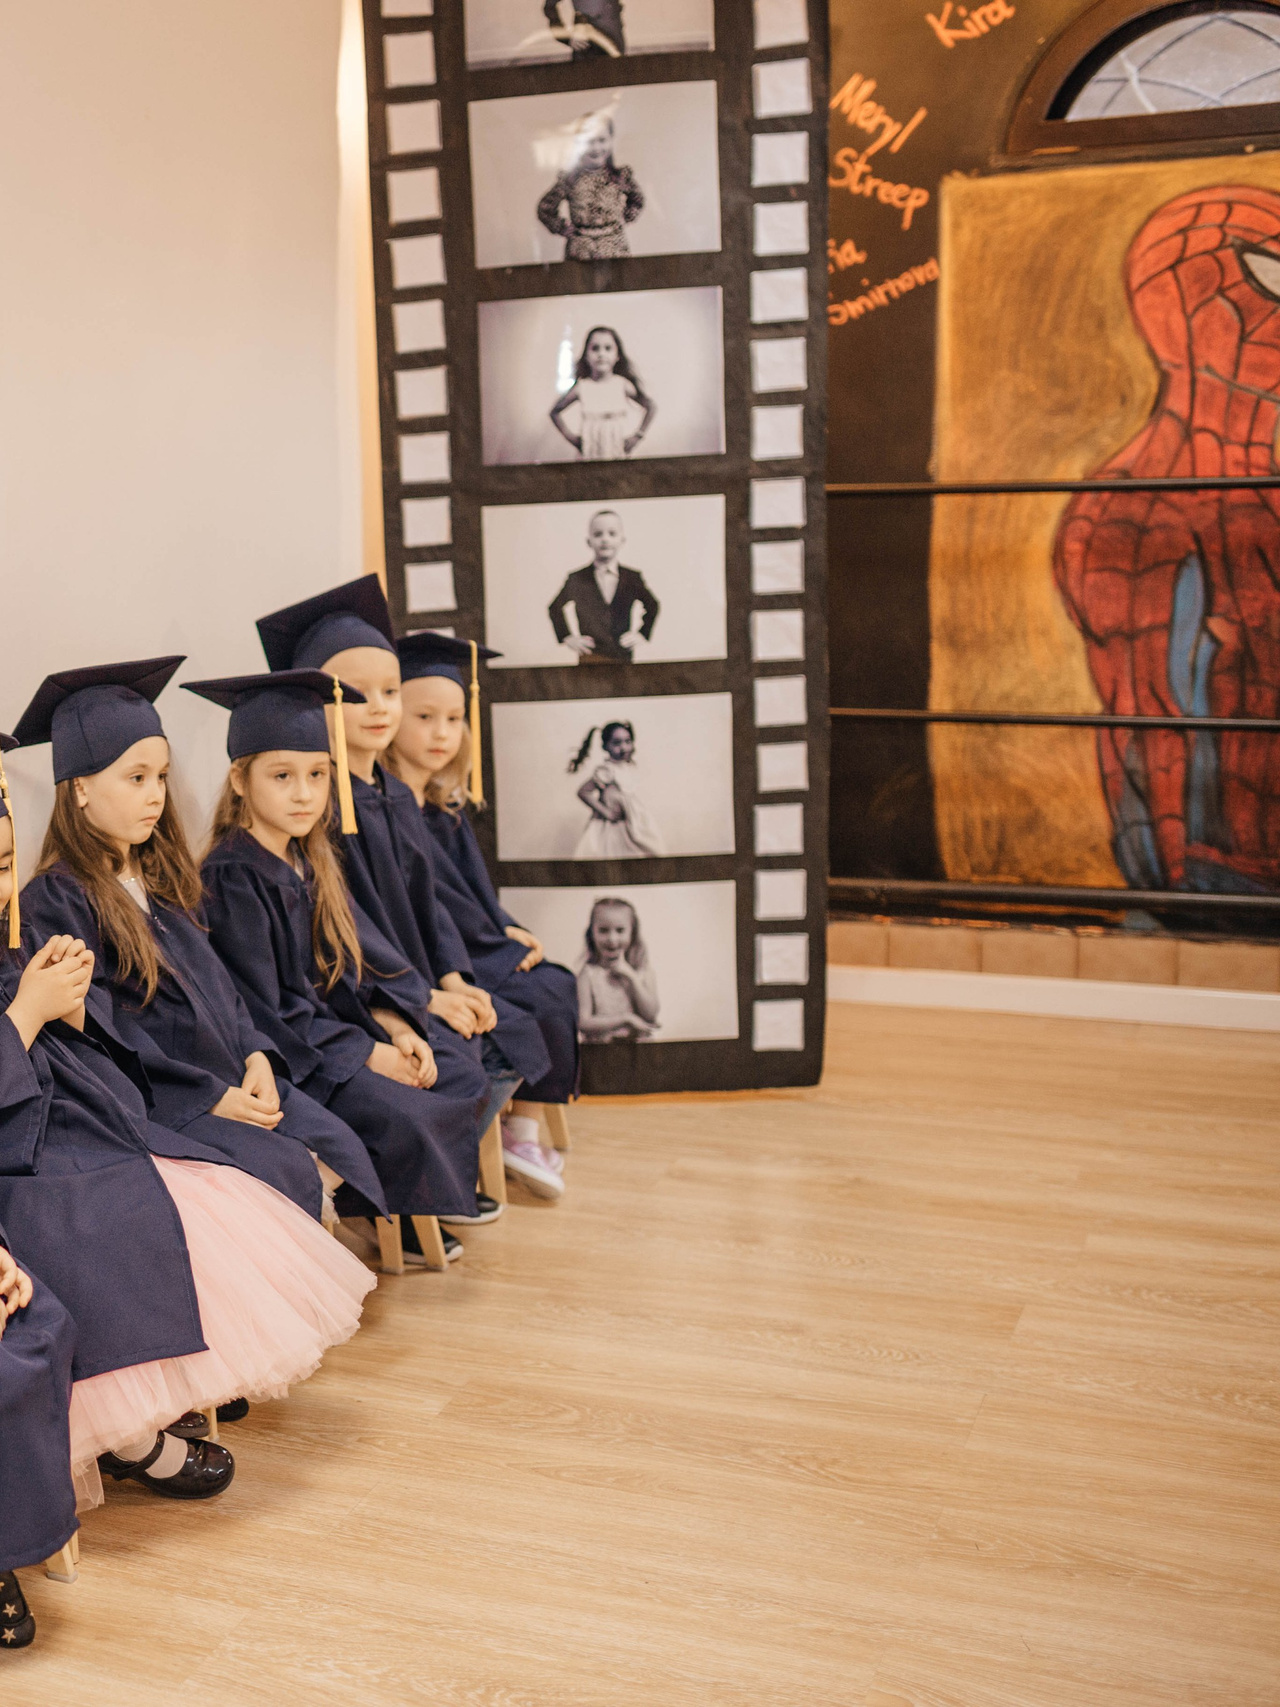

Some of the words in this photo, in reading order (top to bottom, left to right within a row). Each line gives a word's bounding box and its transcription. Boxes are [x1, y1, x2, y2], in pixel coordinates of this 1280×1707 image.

[925, 0, 1015, 48] Kira
[828, 72, 927, 158] Meryl
[827, 147, 930, 231] Streep
